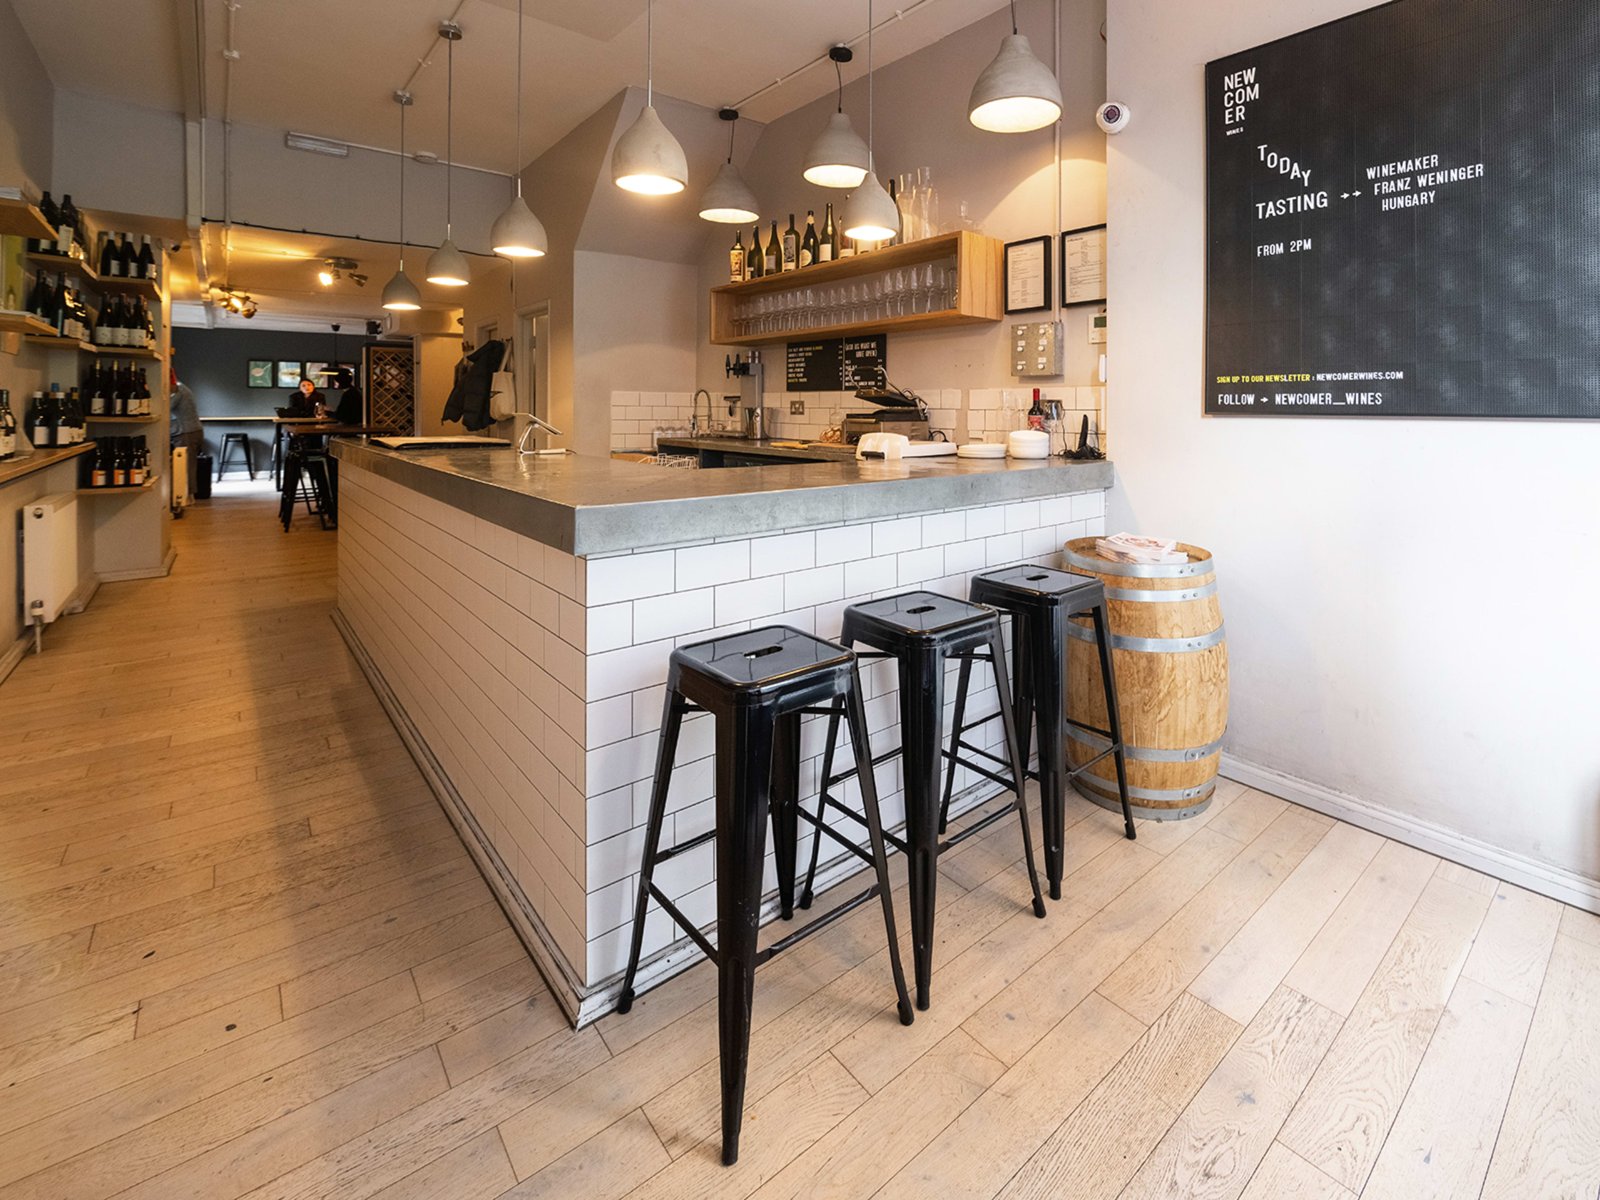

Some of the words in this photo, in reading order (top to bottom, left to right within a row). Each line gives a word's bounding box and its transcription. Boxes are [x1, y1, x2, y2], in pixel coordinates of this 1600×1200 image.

[1224, 67, 1256, 91] NEW
[1224, 84, 1259, 107] COM
[1225, 106, 1245, 124] ER
[1257, 145, 1311, 187] TODAY
[1366, 154, 1439, 182] WINEMAKER
[1374, 173, 1412, 195] FRANZ
[1416, 164, 1484, 188] WENINGER
[1256, 191, 1329, 220] TASTING
[1381, 191, 1436, 212] HUNGARY
[1257, 243, 1284, 257] FROM
[1290, 239, 1312, 253] 2PM
[1216, 376, 1231, 384] SIGN
[1251, 375, 1264, 383] OUR
[1265, 374, 1310, 382] NEWSLETTER
[1316, 371, 1404, 381] NEWCOMERWINES.COM
[1217, 393, 1255, 405] FOLLOW
